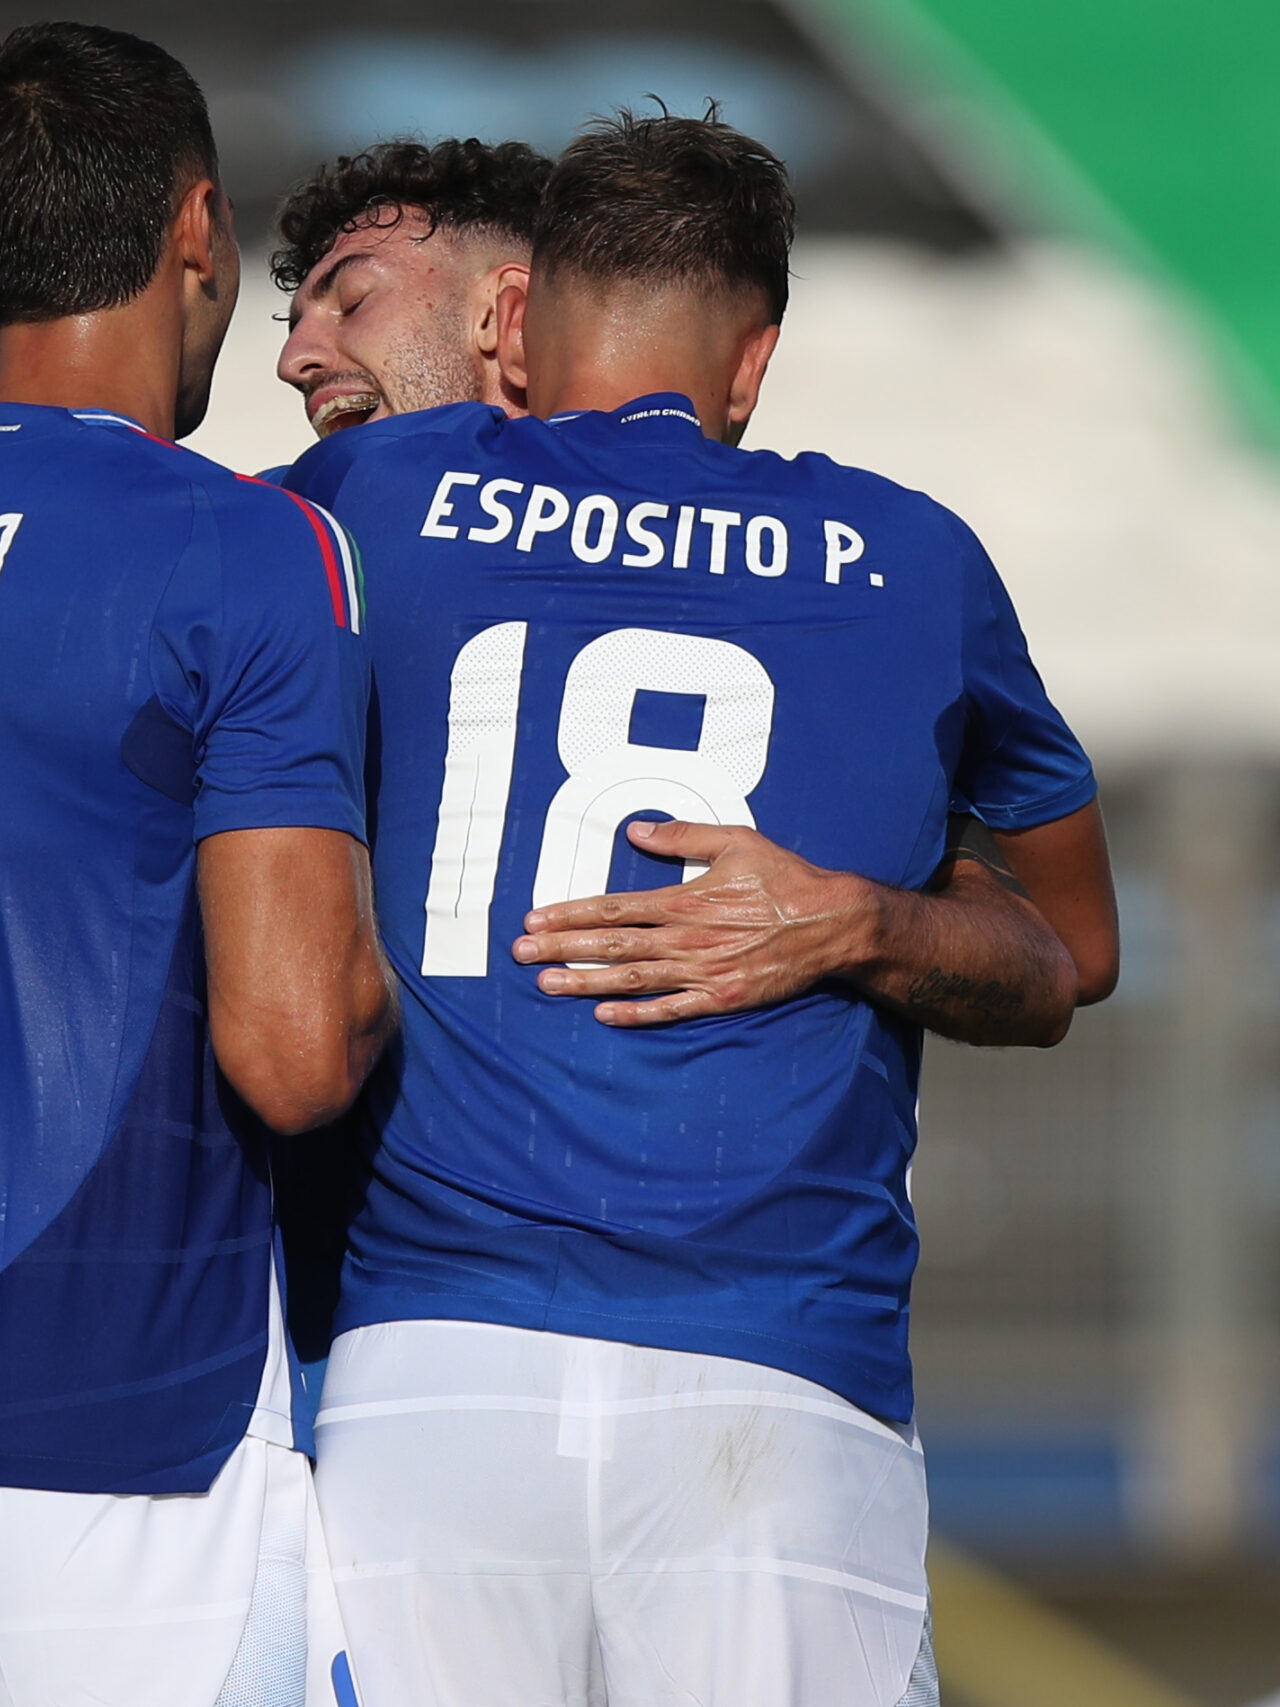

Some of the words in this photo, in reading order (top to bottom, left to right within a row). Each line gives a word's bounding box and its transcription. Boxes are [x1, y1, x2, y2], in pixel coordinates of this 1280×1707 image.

[419, 471, 789, 578] ESPOSITO
[823, 520, 885, 587] P.
[420, 621, 776, 977] 18
